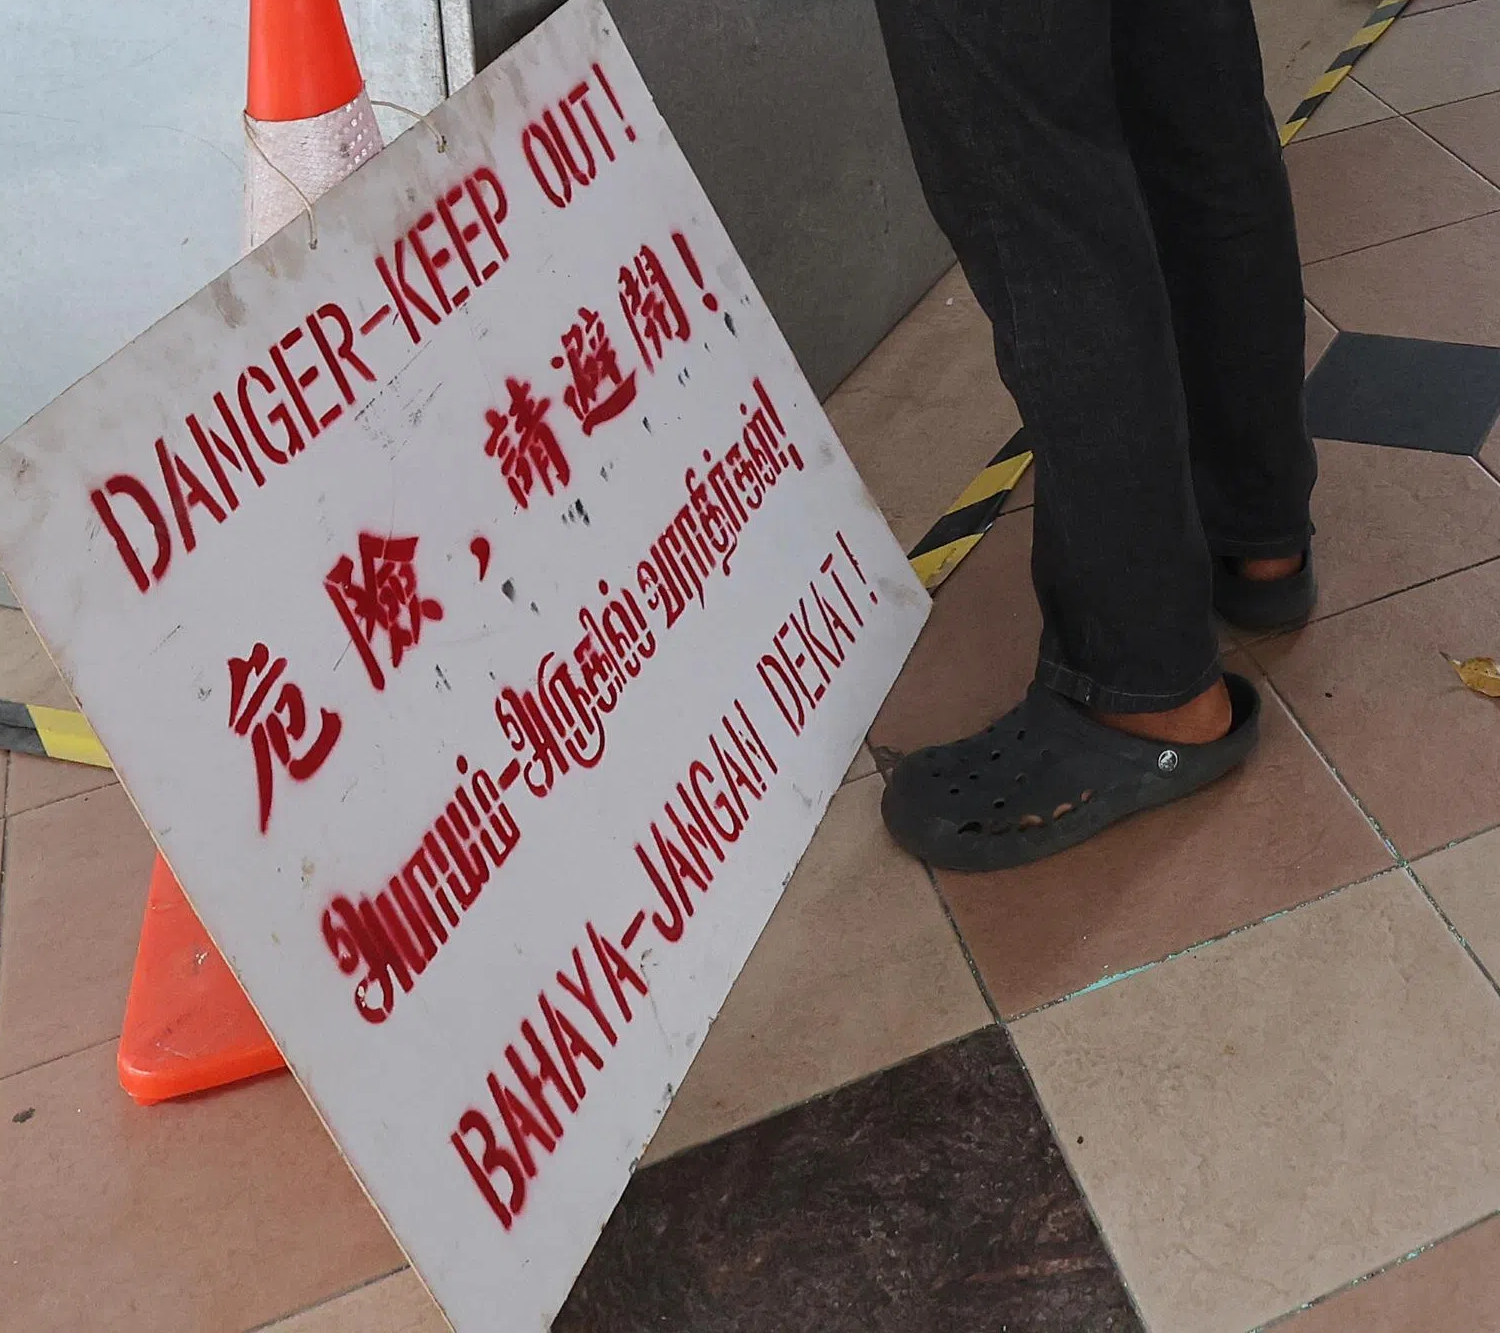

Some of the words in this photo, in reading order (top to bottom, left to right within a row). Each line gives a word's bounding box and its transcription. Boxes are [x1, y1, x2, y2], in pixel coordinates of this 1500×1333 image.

[88, 165, 510, 595] DANGER-KEEP
[521, 63, 637, 209] OUT!
[450, 698, 776, 1233] BAHAYA-JANGAN
[757, 531, 882, 735] DEKAT!
